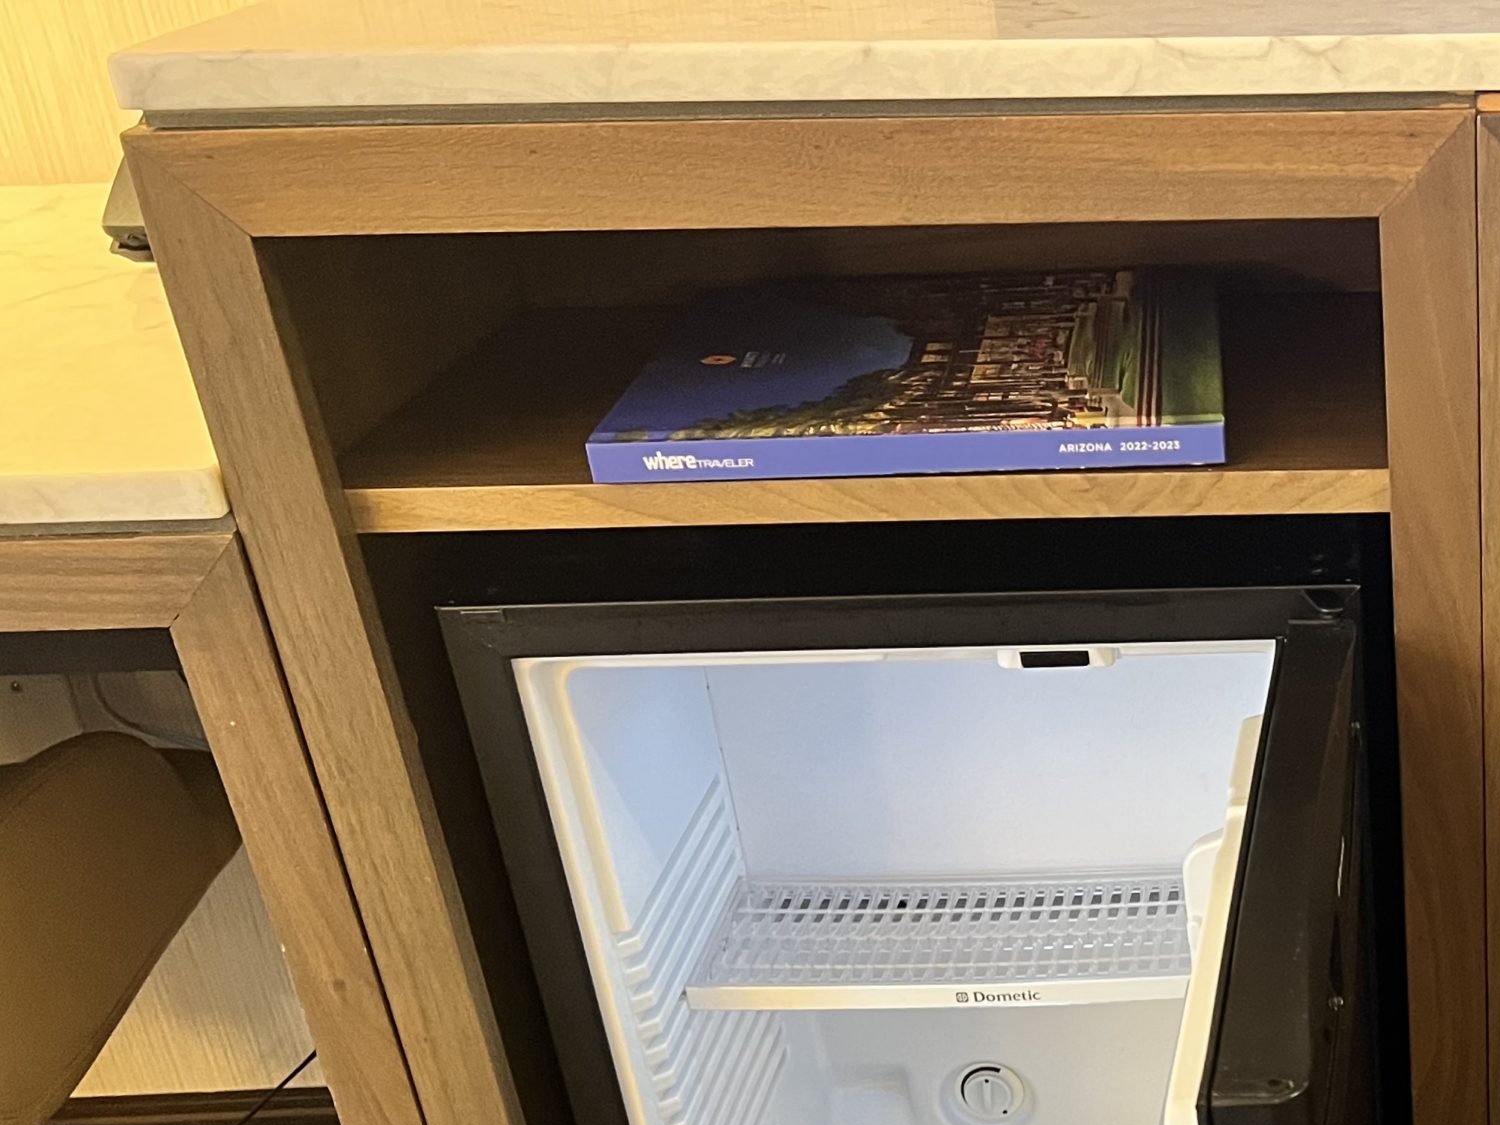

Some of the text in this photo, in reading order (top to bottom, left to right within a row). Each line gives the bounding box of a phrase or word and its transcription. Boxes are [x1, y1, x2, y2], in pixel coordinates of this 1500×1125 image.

[1058, 440, 1181, 453] ARIZONA 2022-2023
[973, 990, 1042, 1003] Dometic
